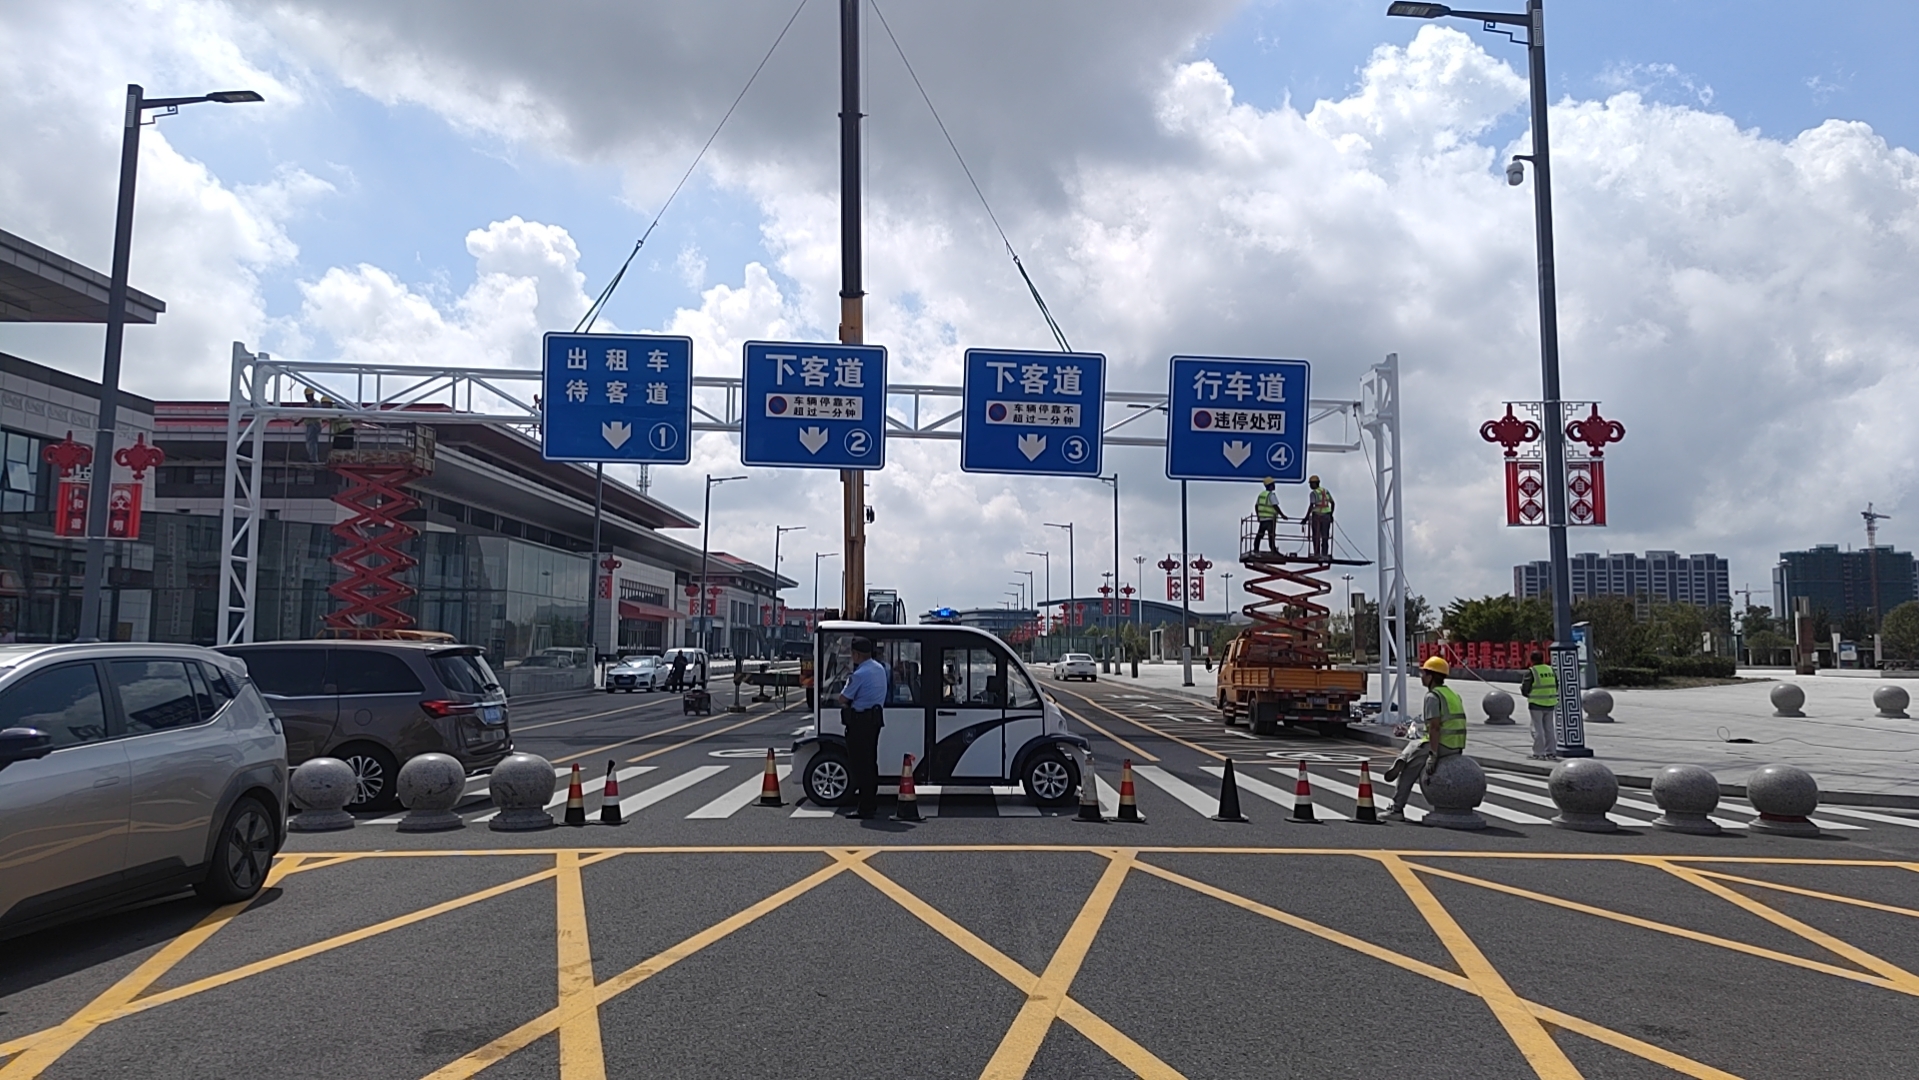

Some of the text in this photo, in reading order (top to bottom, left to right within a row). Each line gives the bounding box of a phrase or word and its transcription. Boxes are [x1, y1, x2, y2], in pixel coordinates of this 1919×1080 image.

[567, 347, 669, 372] 出租车
[765, 353, 865, 388] 下客道
[986, 361, 1083, 396] 下客道
[1193, 369, 1287, 403] 行车道
[566, 379, 669, 405] 待客道
[793, 396, 857, 408] 车辆停靠不
[793, 407, 856, 418] 超过一分钟
[1013, 404, 1074, 415] 车辆停靠不
[1013, 414, 1074, 426] 超过一分钟
[1214, 411, 1282, 431] 违停处罚
[1575, 480, 1587, 516] 自由
